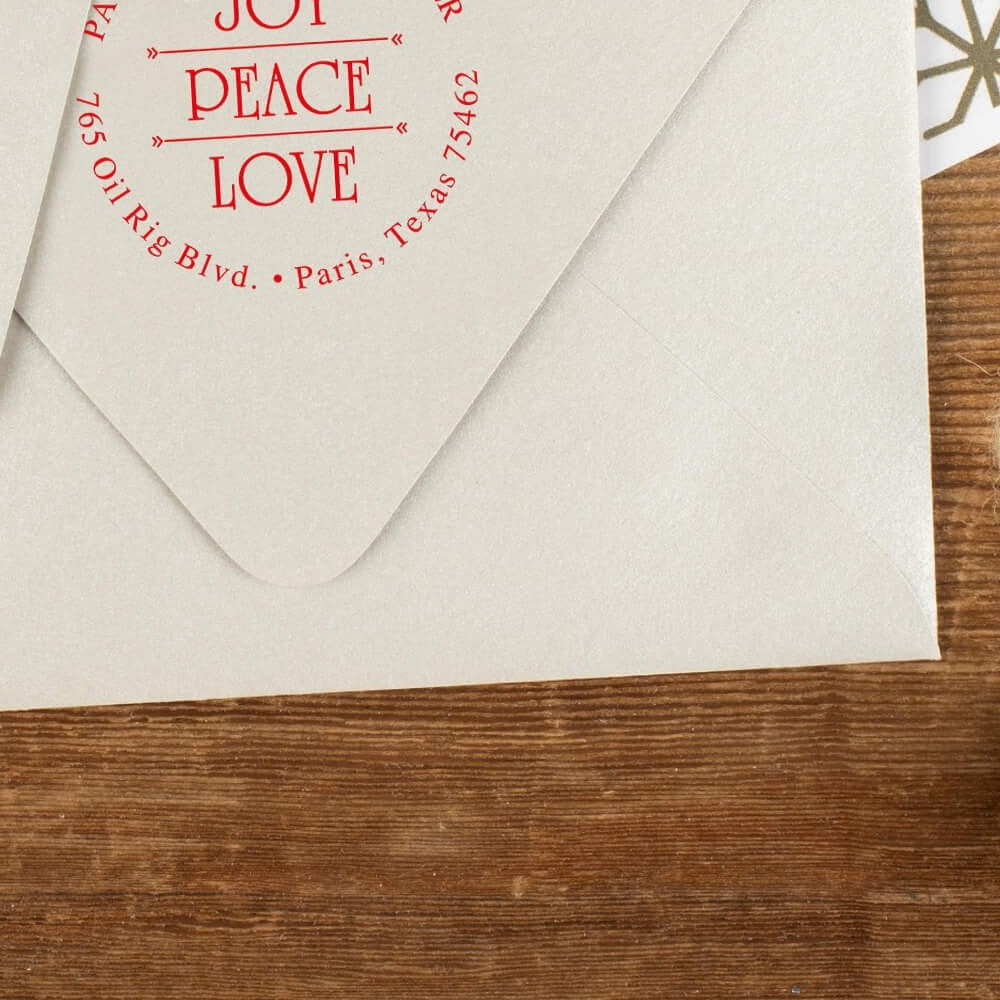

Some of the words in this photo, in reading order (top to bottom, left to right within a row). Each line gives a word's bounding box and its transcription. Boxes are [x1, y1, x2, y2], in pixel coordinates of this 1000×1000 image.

[184, 56, 373, 122] PEACE
[75, 91, 108, 147] 765
[92, 156, 132, 205] Oil
[122, 203, 172, 258] Rig
[175, 242, 259, 290] Blvd.
[294, 252, 386, 291] Paris,
[383, 172, 457, 249] Texas
[442, 69, 480, 164] 75462
[208, 145, 359, 212] LOVE
